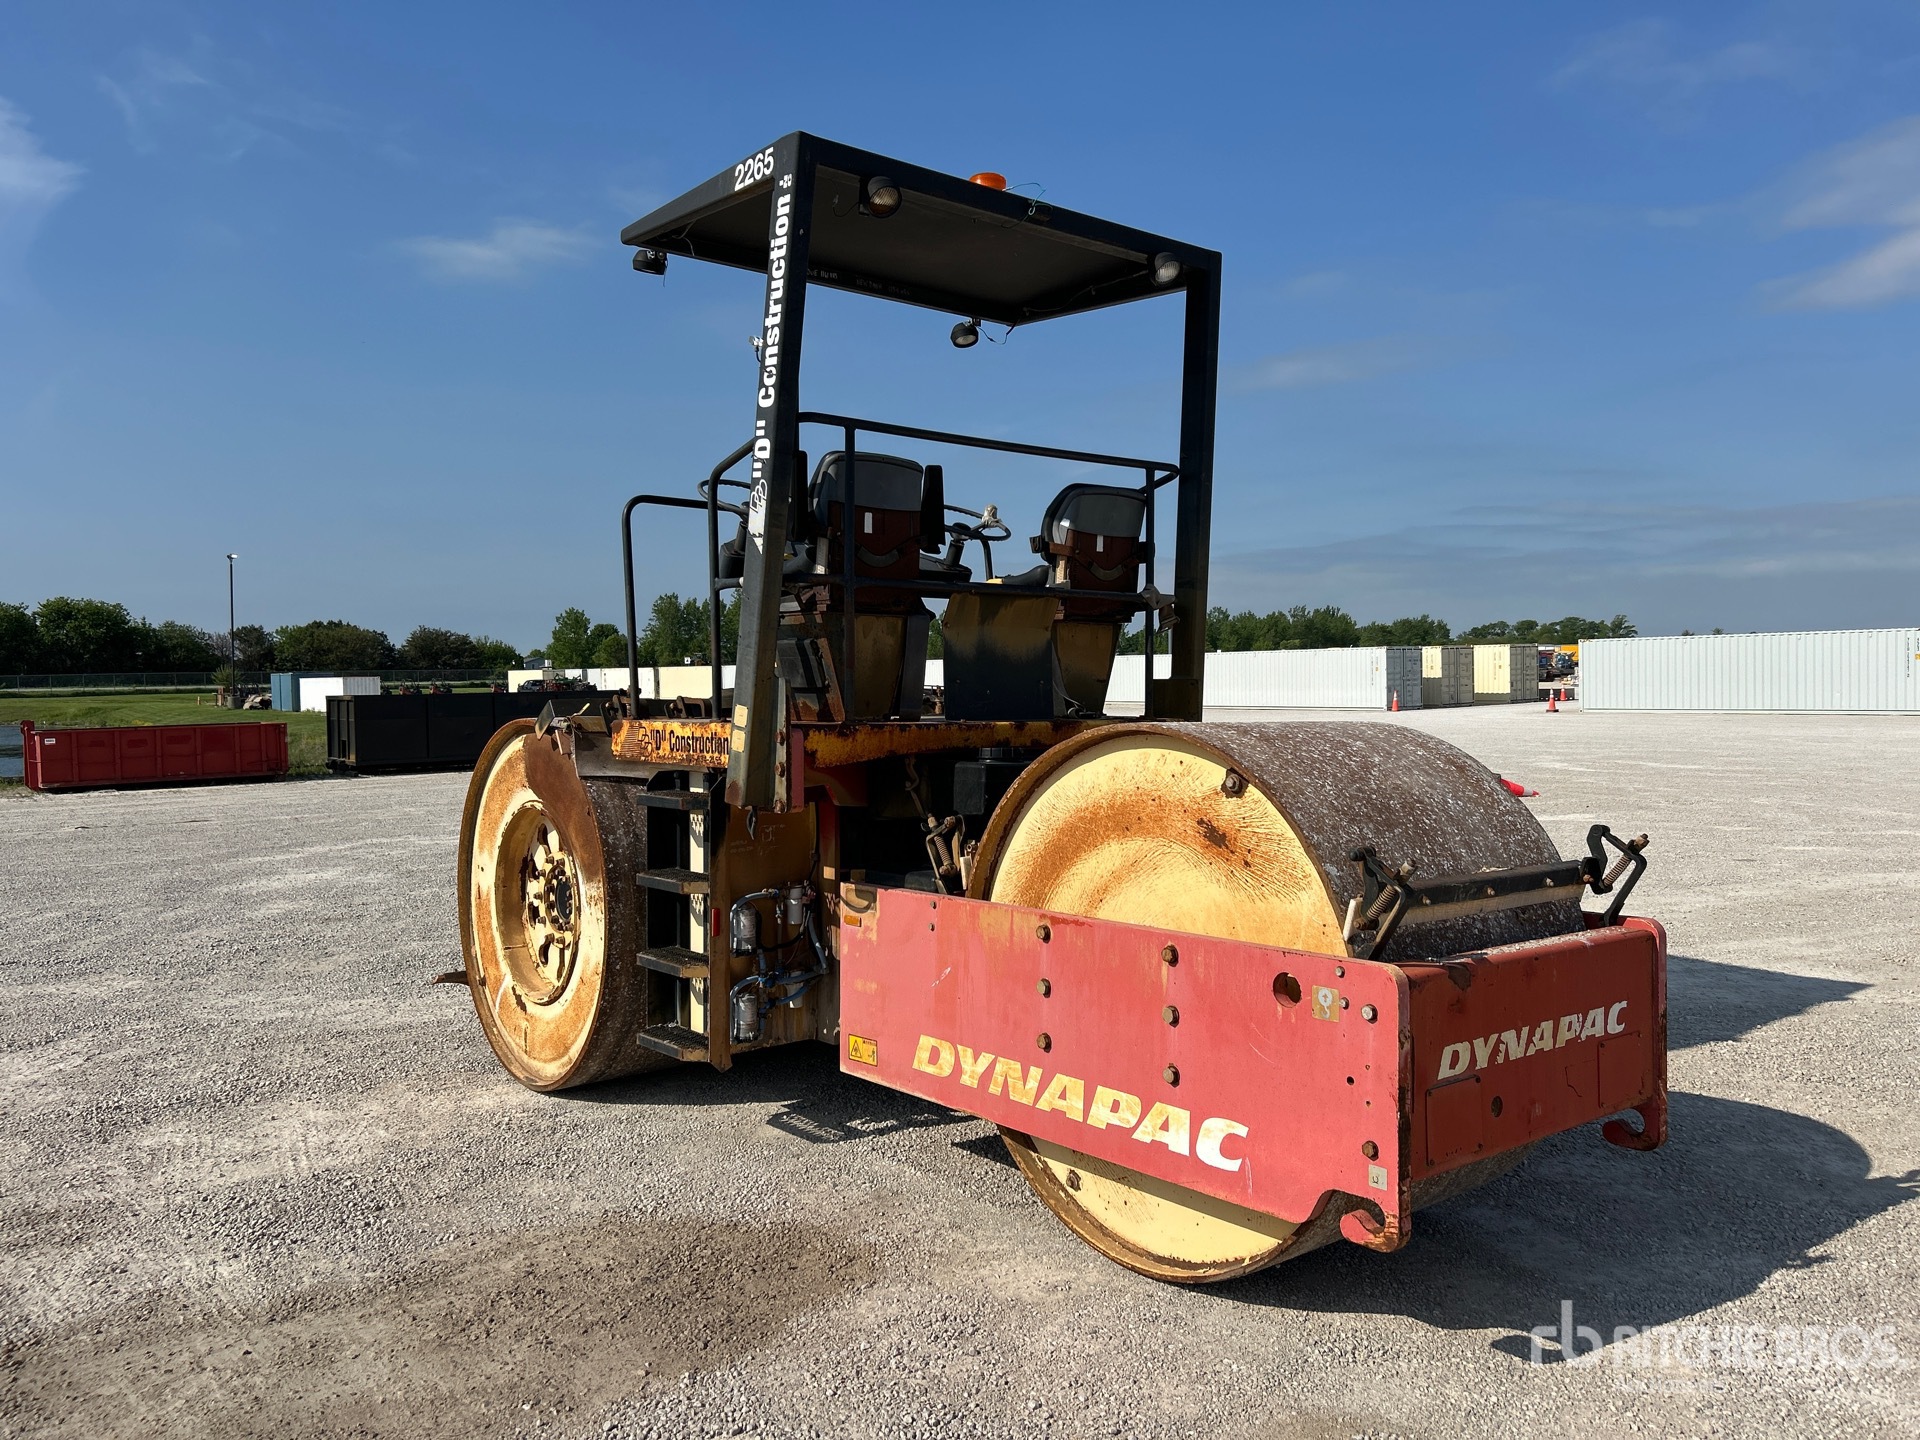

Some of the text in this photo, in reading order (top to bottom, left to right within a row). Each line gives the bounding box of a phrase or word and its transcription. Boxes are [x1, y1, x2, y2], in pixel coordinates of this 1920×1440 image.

[734, 146, 774, 192] 2265
[757, 193, 791, 408] Construction
[669, 730, 729, 755] Construction
[1436, 1000, 1628, 1081] DYNAPAC
[911, 1034, 1249, 1173] DYNAPAC
